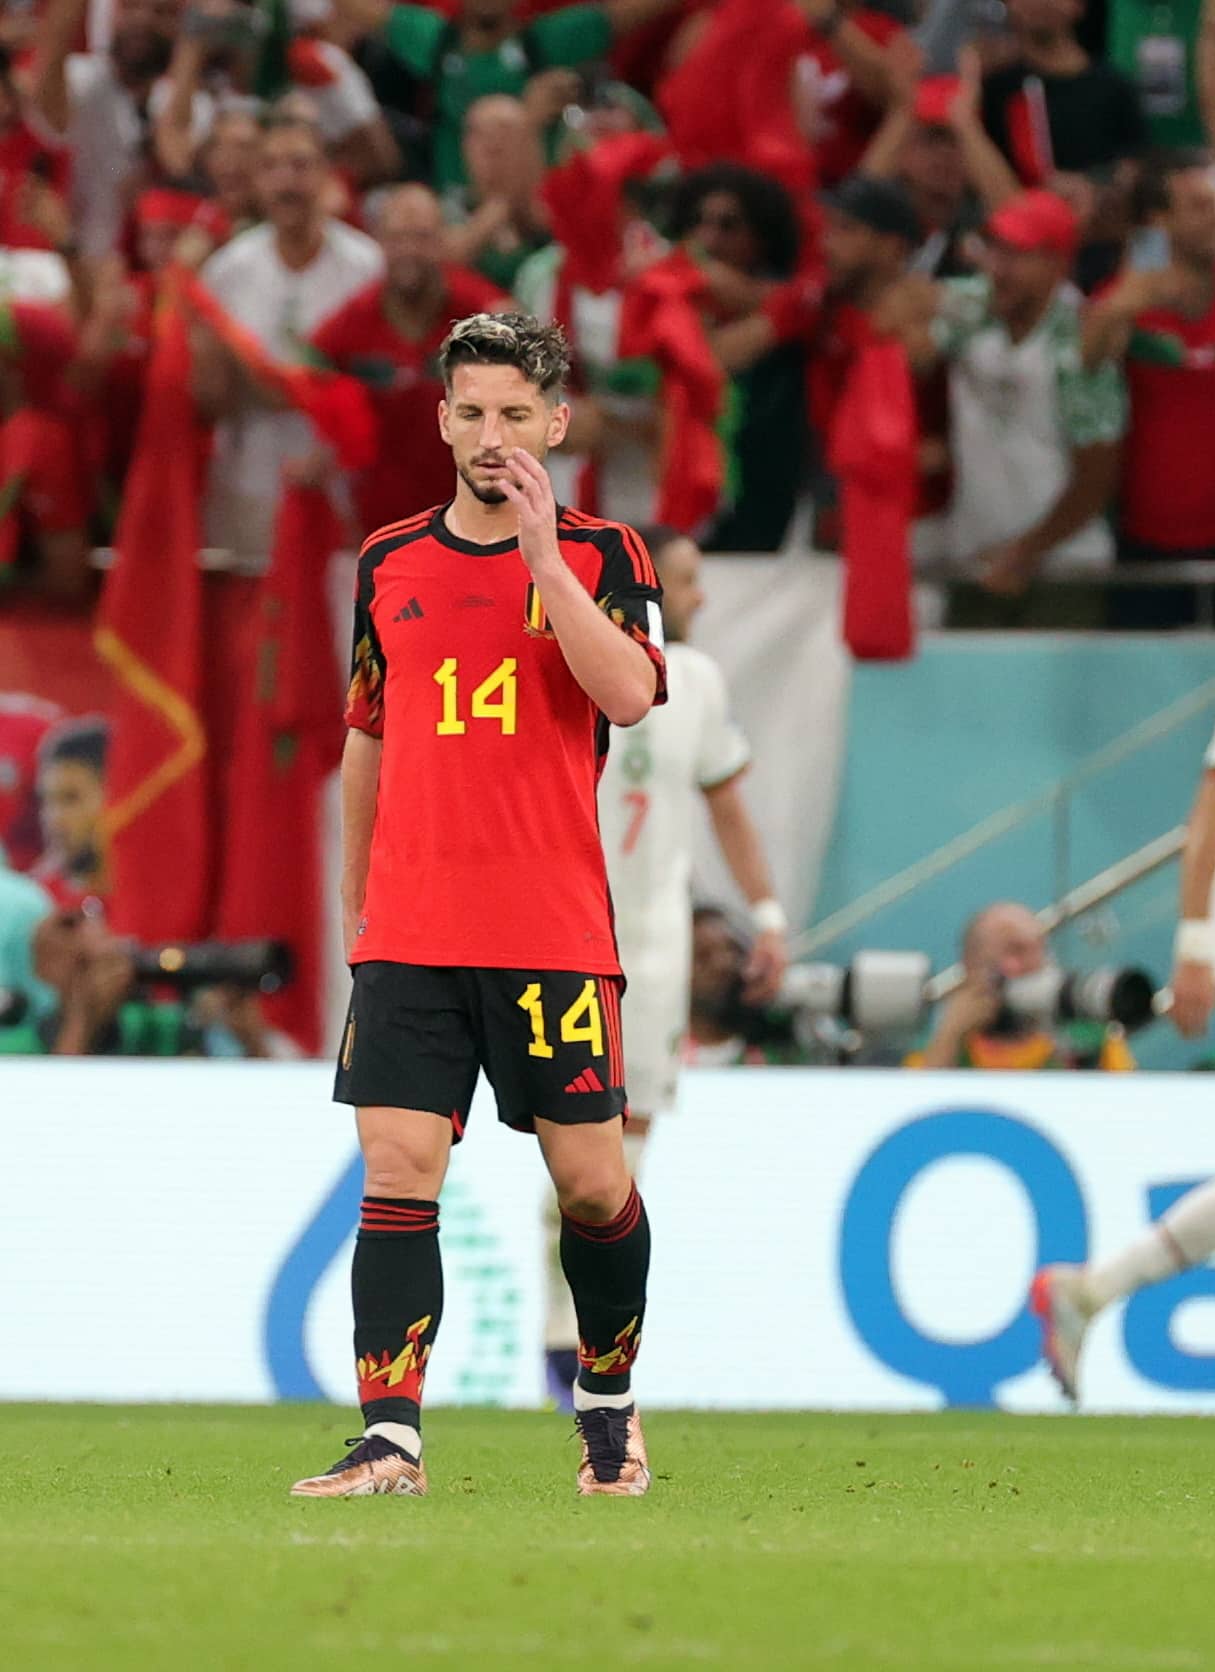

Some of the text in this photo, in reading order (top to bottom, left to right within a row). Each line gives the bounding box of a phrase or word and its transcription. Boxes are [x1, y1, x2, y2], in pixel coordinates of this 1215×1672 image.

[434, 657, 517, 735] 14
[621, 791, 648, 855] 7
[517, 979, 604, 1059] 14
